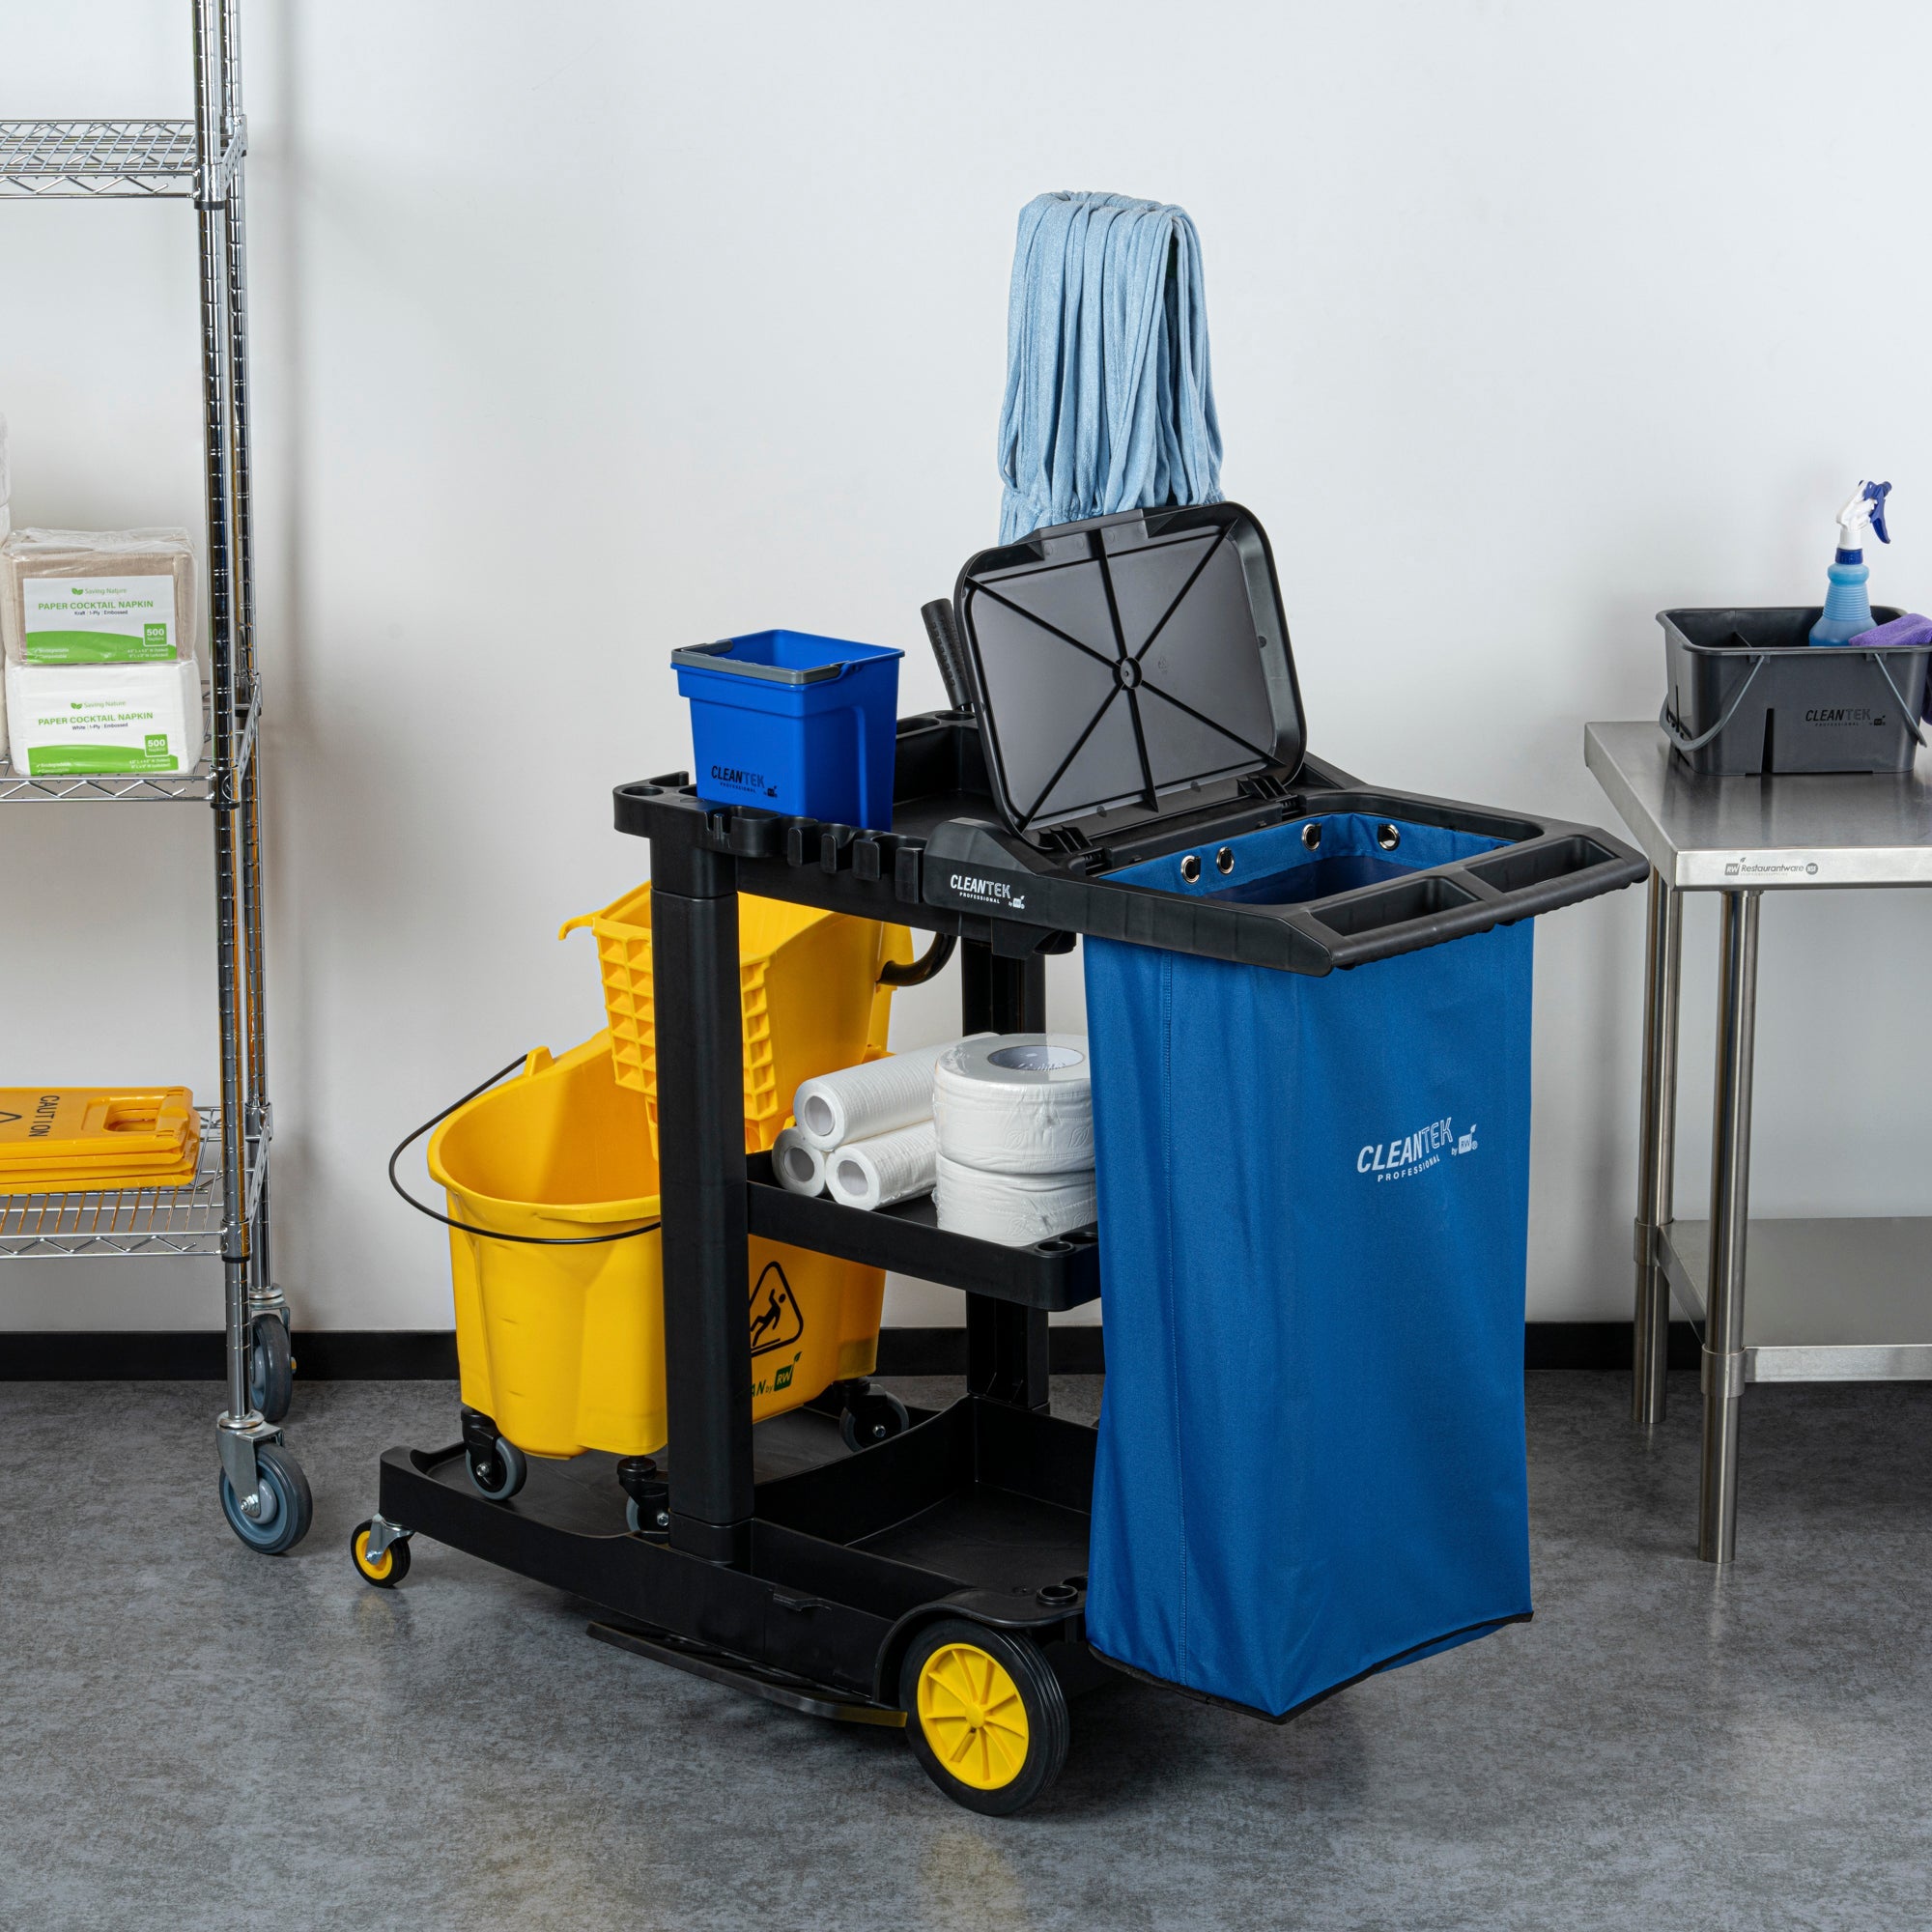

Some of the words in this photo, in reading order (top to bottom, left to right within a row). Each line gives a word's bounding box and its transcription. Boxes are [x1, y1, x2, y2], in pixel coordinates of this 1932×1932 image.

[38, 602, 68, 611] PAPER
[70, 601, 116, 610] COCKTAIL
[118, 600, 154, 609] NAPKIN
[147, 628, 165, 637] 500
[70, 715, 116, 724] COCKTAIL
[118, 712, 154, 721] NAPKIN
[1805, 709, 1871, 722] CLEANTEK
[711, 765, 765, 788] CLEANTEK
[1741, 864, 1804, 872] Restaurantware
[950, 874, 1011, 899] CLEANTEK
[959, 892, 1001, 904] PROFESSIONAL
[28, 1095, 60, 1137] CAUTION
[1356, 1116, 1454, 1174] CLEANTEK
[1451, 1147, 1459, 1156] by
[1377, 1153, 1440, 1182] PROFESSIONAL
[776, 1371, 791, 1385] RW
